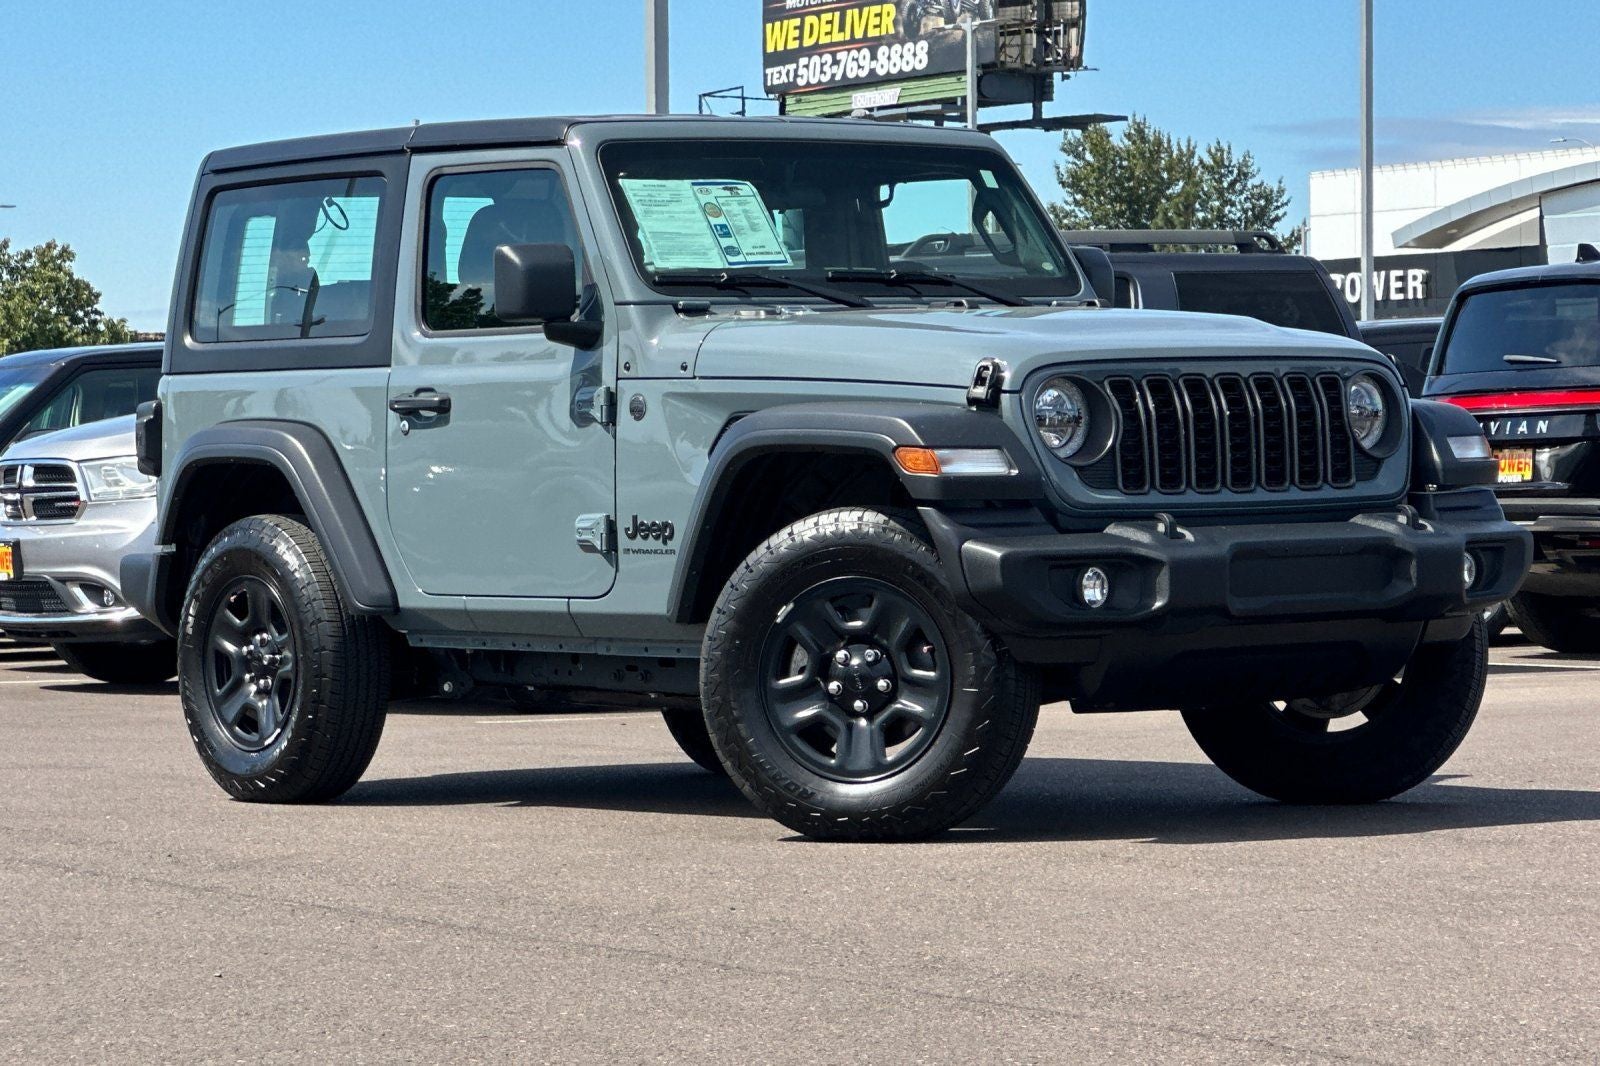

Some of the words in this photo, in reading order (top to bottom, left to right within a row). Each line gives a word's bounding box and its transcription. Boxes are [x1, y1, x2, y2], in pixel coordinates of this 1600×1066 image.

[766, 18, 800, 53] WE
[802, 3, 896, 47] DELIVER
[766, 63, 796, 86] TEXT
[796, 40, 929, 86] 503-769-8888
[1494, 453, 1532, 473] OWER
[624, 514, 675, 546] Jeep
